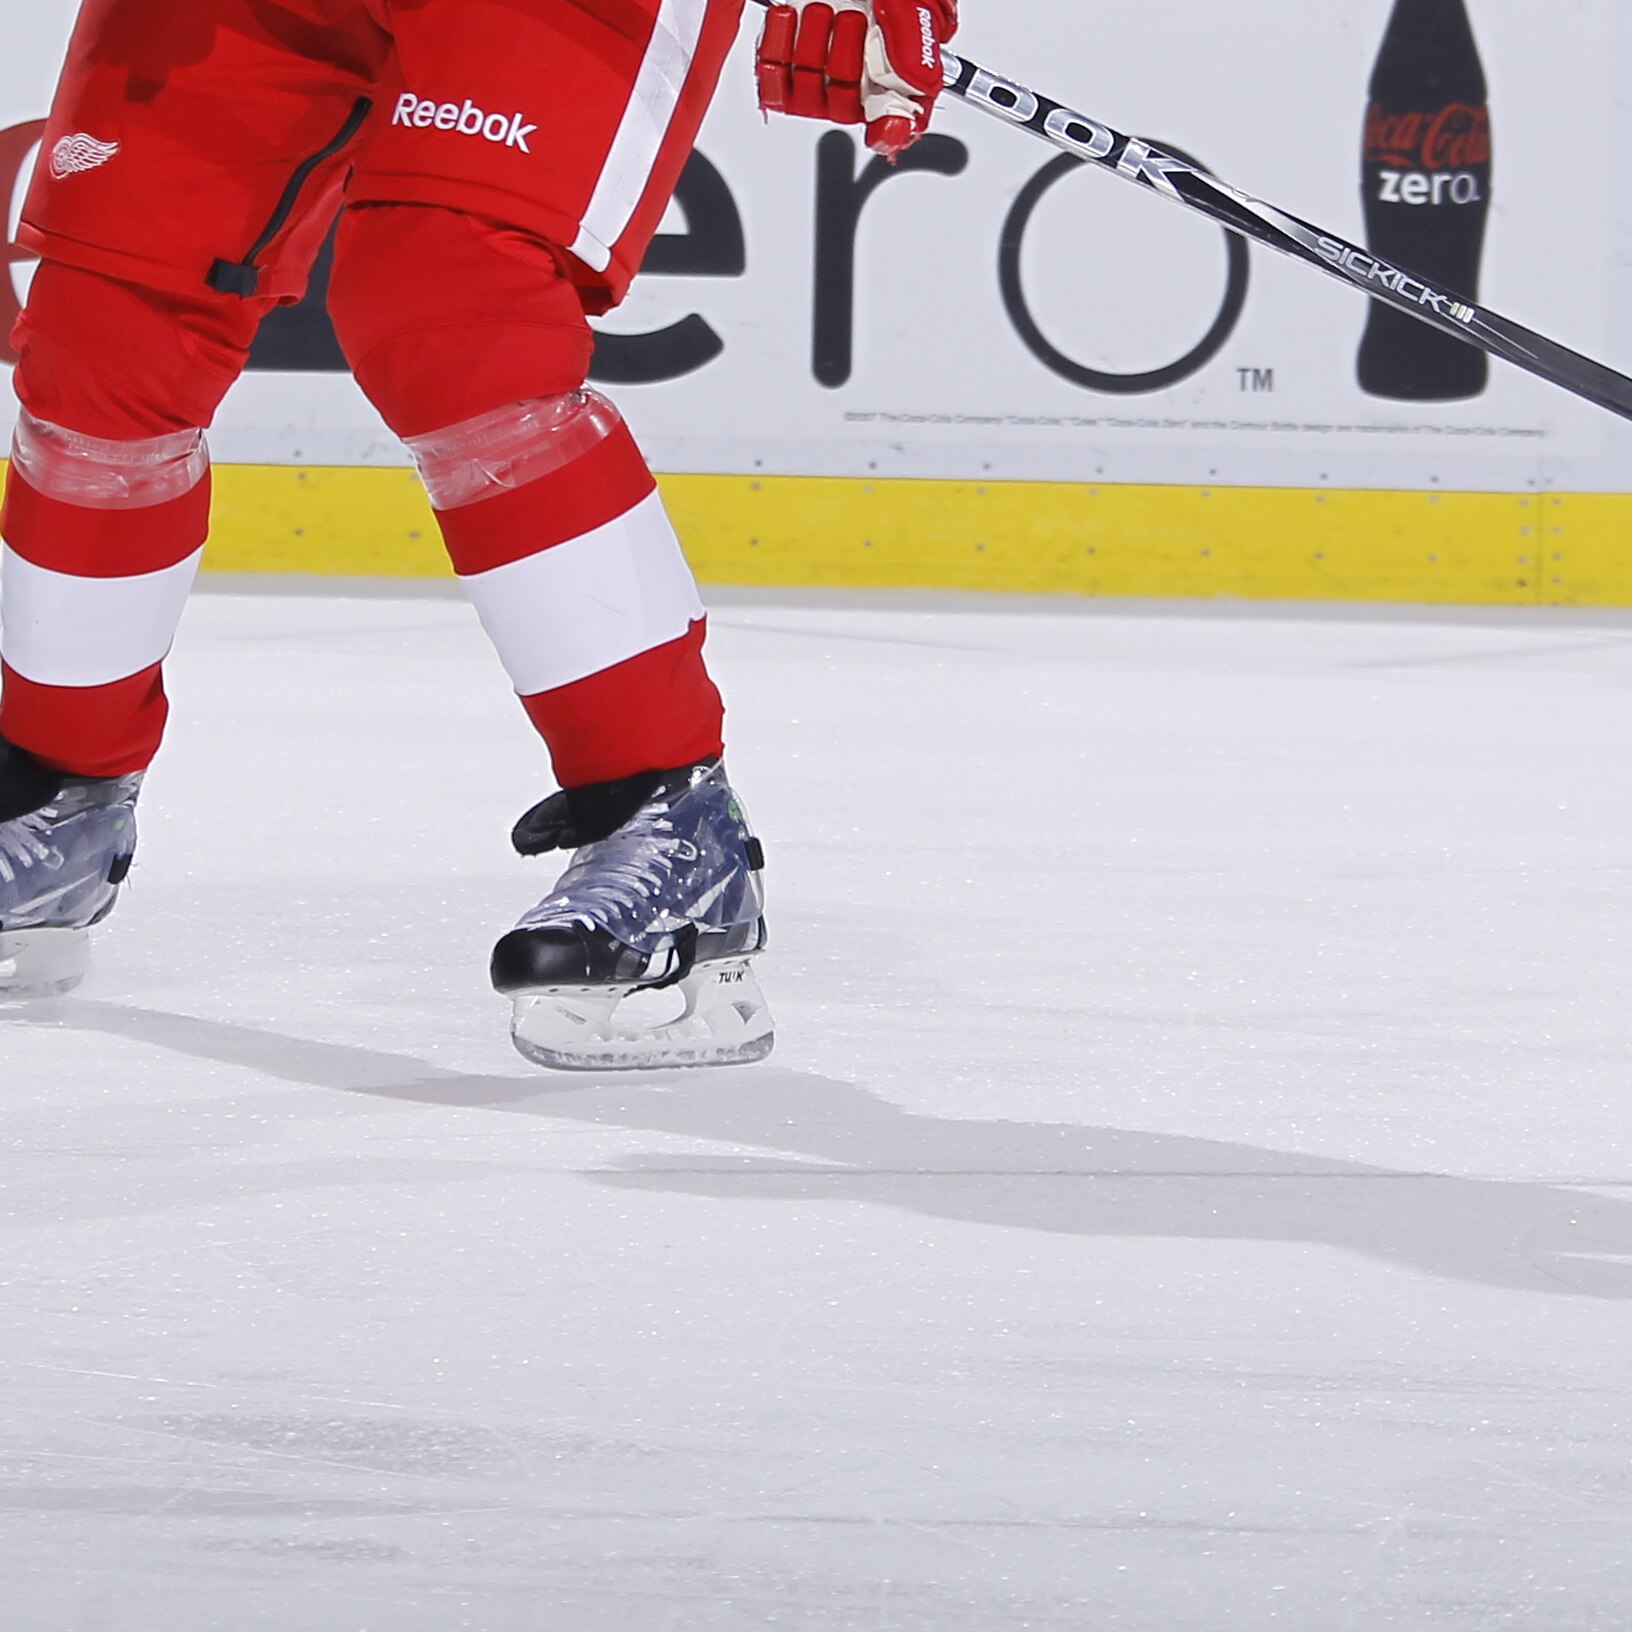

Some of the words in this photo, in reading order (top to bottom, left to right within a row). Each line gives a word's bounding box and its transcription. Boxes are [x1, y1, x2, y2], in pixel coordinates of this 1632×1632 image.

[915, 6, 936, 70] Reebok
[391, 92, 539, 155] Reebok
[1313, 235, 1448, 314] SICKICK
[1236, 367, 1274, 393] TM
